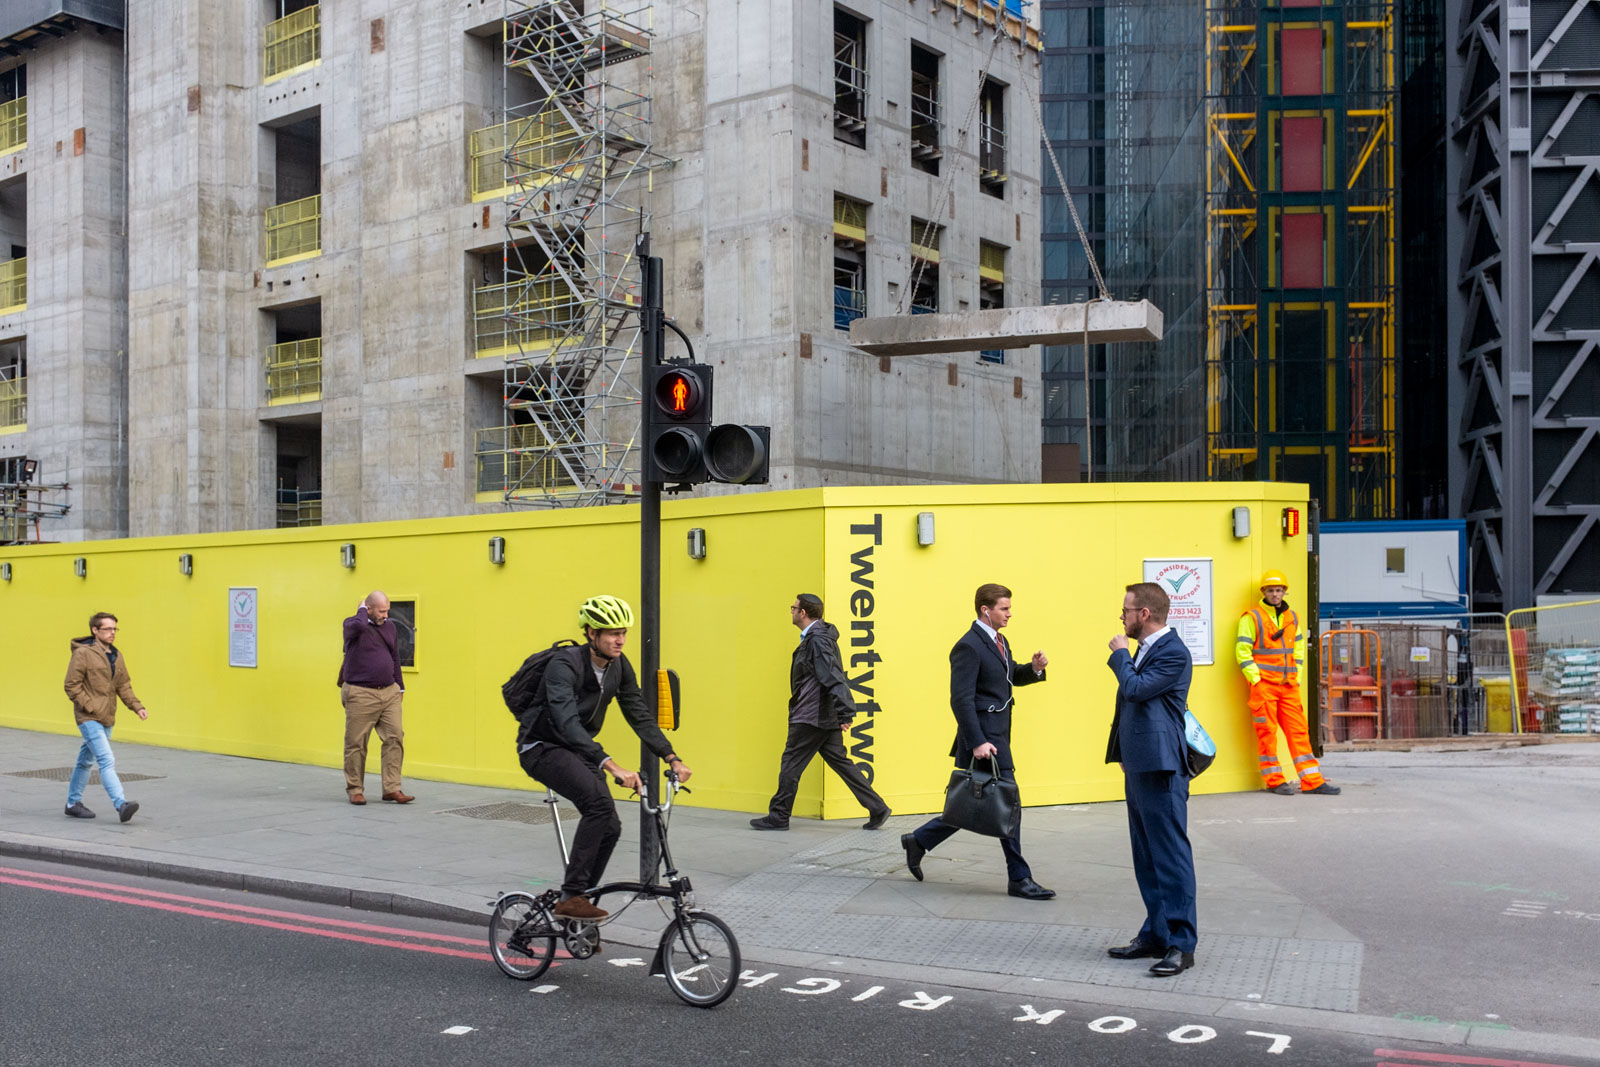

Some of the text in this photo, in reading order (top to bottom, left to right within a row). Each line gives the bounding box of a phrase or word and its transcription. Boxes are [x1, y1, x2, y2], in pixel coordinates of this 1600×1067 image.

[1155, 564, 1201, 581] CONSIDERATE
[1168, 584, 1201, 600] TRUCTORS
[1013, 1004, 1292, 1054] LOOK
